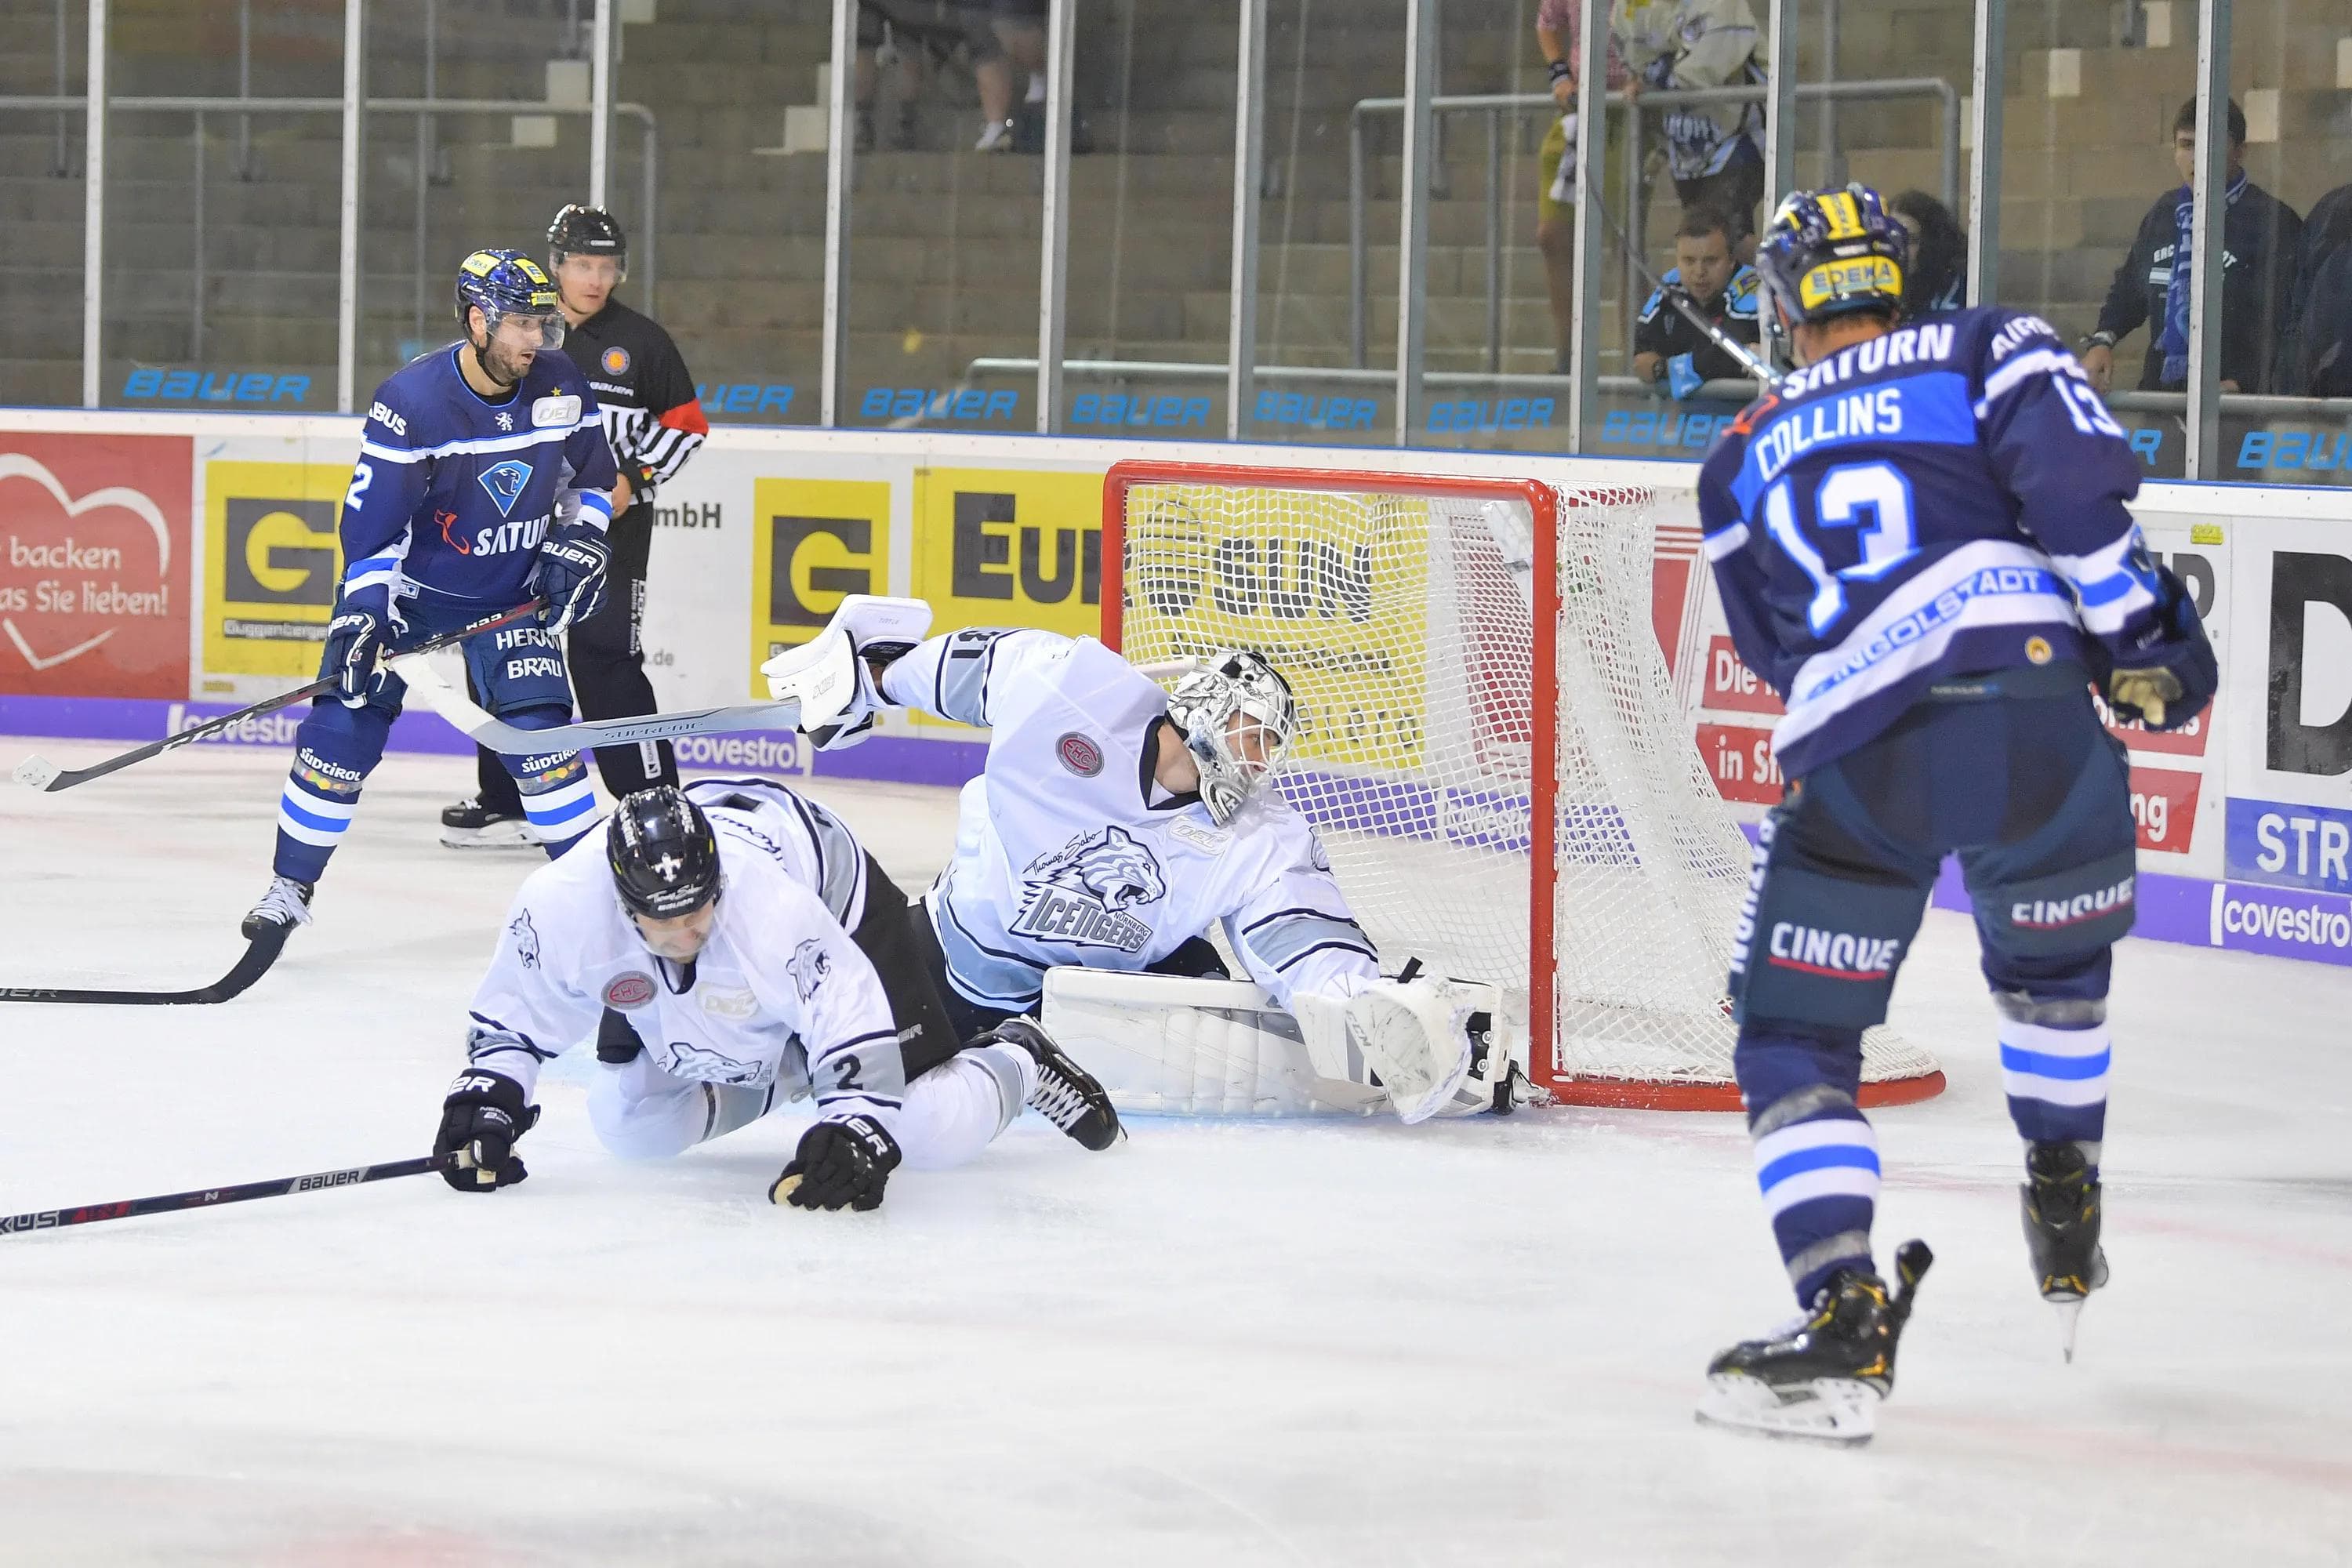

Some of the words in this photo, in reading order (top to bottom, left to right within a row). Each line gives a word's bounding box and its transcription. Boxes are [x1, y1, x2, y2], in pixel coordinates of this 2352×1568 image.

[1813, 263, 1892, 289] EDEKA
[1781, 323, 1956, 400] SATURN
[123, 369, 311, 402] BAUER
[862, 386, 1019, 420] BAUER
[1070, 393, 1212, 427] BAUER
[1254, 390, 1379, 430] BAUER
[1426, 397, 1555, 435] BAUER
[2053, 373, 2125, 438] 13
[1755, 387, 1903, 482] COLLINS
[2236, 430, 2352, 470] BAU
[654, 502, 721, 529] mbH
[10, 535, 122, 572] backen
[473, 514, 550, 557] SATUR
[1764, 460, 1918, 637] 13
[0, 587, 28, 612] as
[36, 580, 75, 614] Sie
[82, 580, 169, 616] lieben!
[224, 619, 328, 641] Guggenberge
[496, 627, 561, 652] HERRN
[1832, 568, 2039, 683] INGOLSTADT
[506, 656, 563, 681] BRÄU
[1714, 649, 1758, 695] Die
[182, 712, 299, 746] covestr
[672, 734, 798, 769] covestro
[1718, 733, 1744, 782] in
[1022, 851, 1063, 877] Thomas
[2256, 812, 2350, 881] STR
[2011, 876, 2135, 924] CINQUE
[1113, 911, 1150, 938] NÜRNBERG
[2223, 900, 2351, 948] covestro
[1769, 920, 1900, 971] CINQUE
[833, 1053, 863, 1091] 2
[298, 1170, 361, 1192] BAUER
